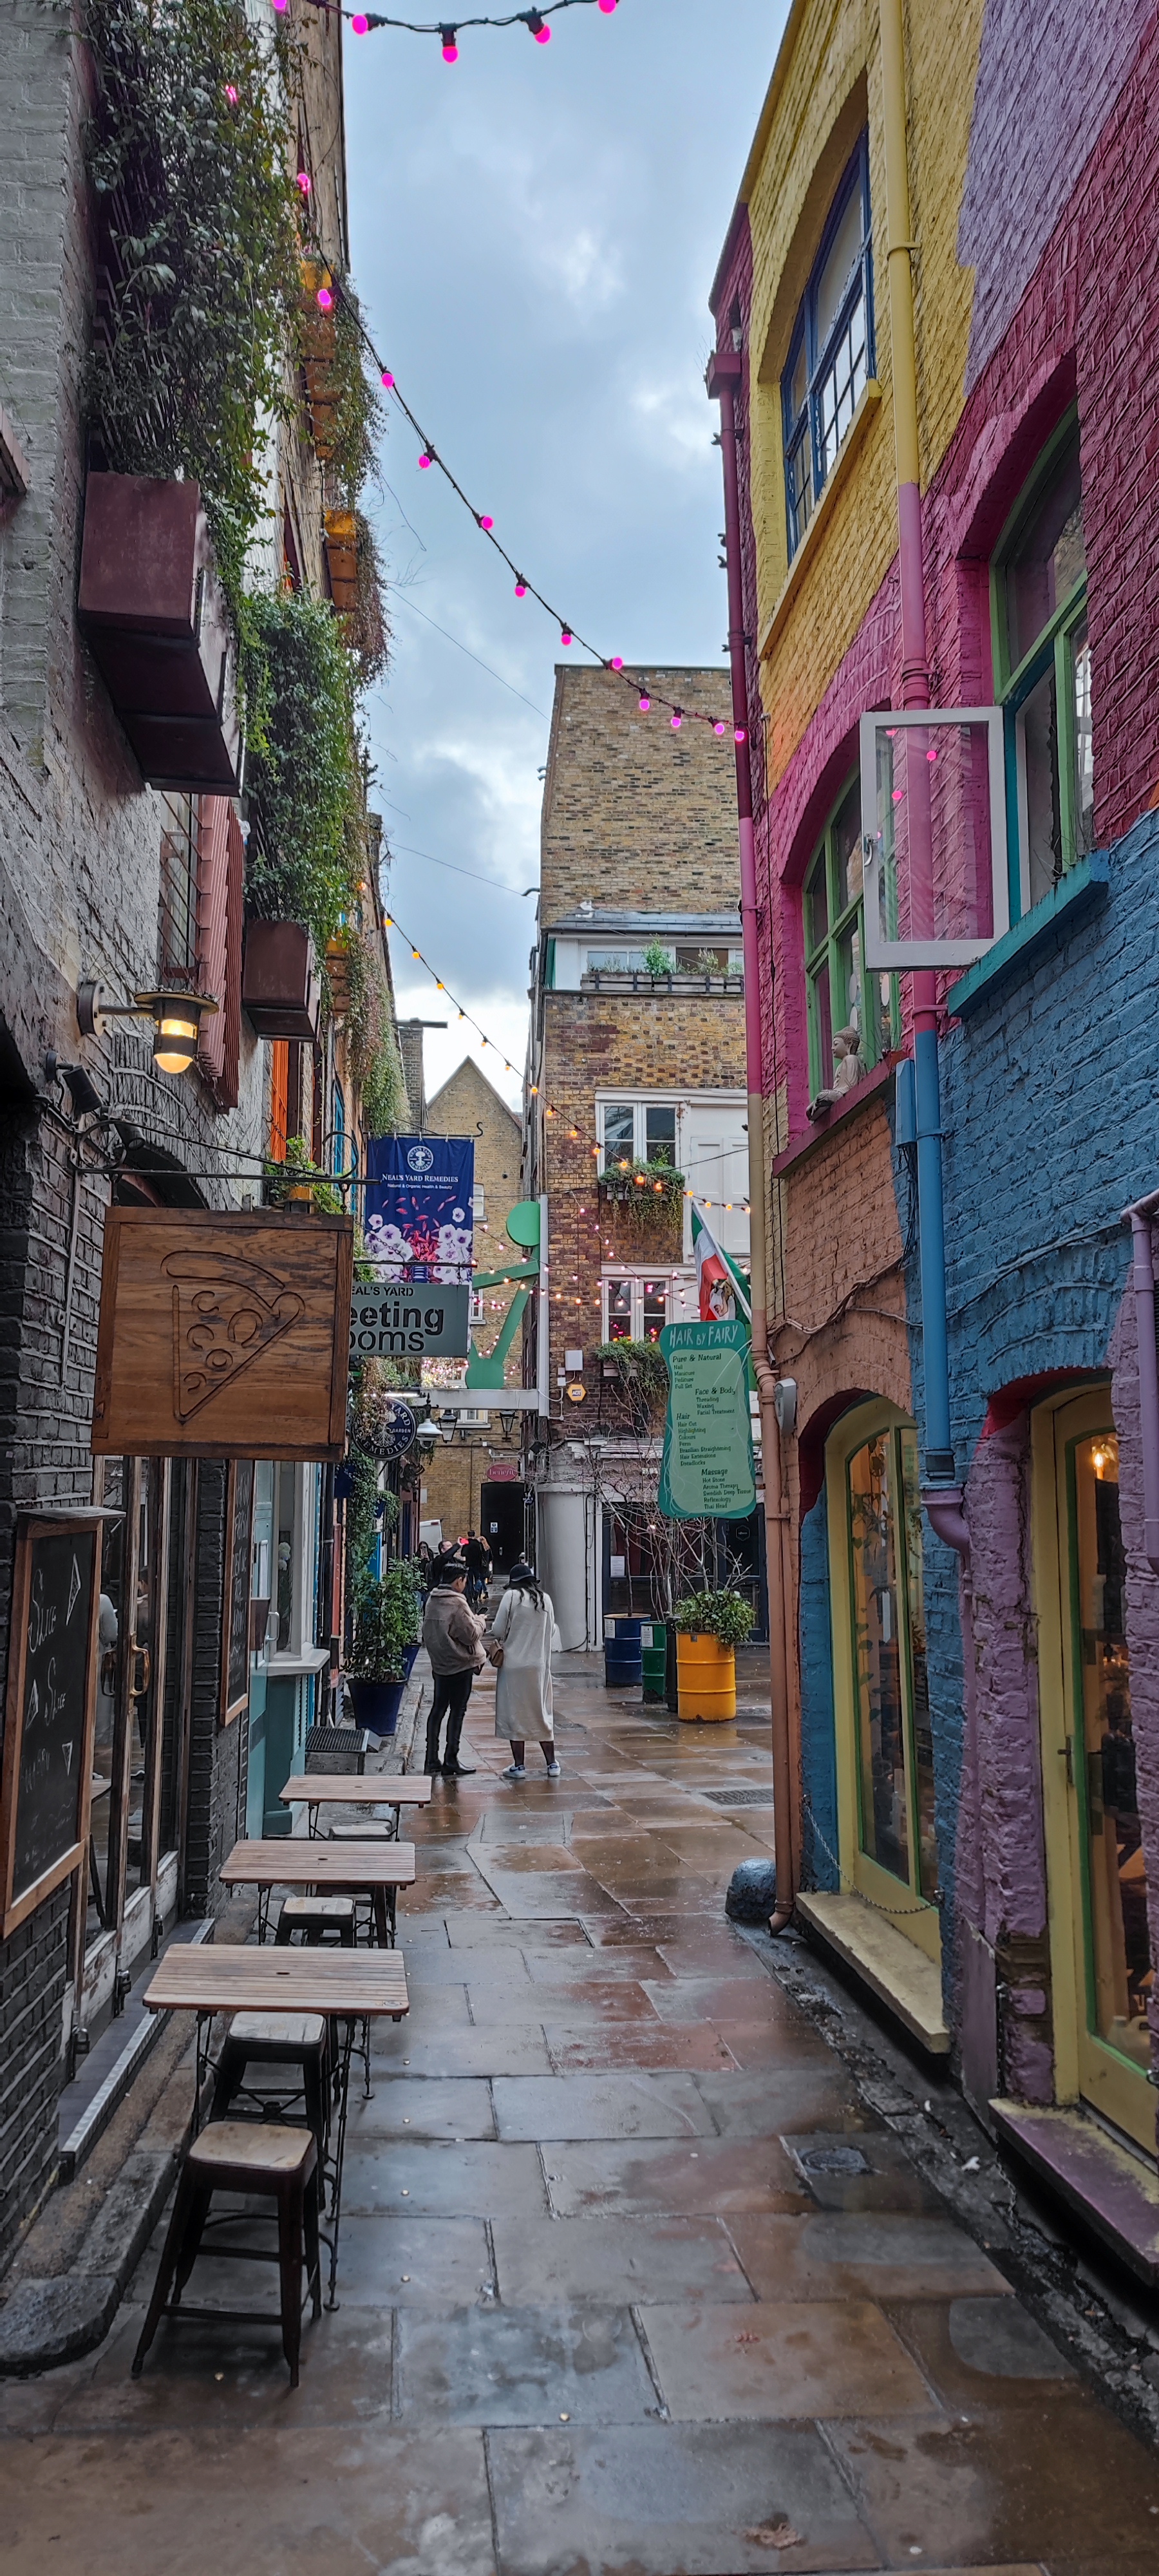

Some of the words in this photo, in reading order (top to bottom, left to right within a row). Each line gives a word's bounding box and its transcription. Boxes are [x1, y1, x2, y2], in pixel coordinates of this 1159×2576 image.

[383, 1287, 414, 1296] YARD
[670, 1327, 693, 1349] HAIR
[696, 1332, 706, 1345] BY
[708, 1325, 738, 1346] FAIRY
[720, 1386, 735, 1395] Body
[391, 1403, 411, 1426] YARD
[362, 1435, 409, 1455] EMEDIES
[701, 1468, 728, 1477] Massage
